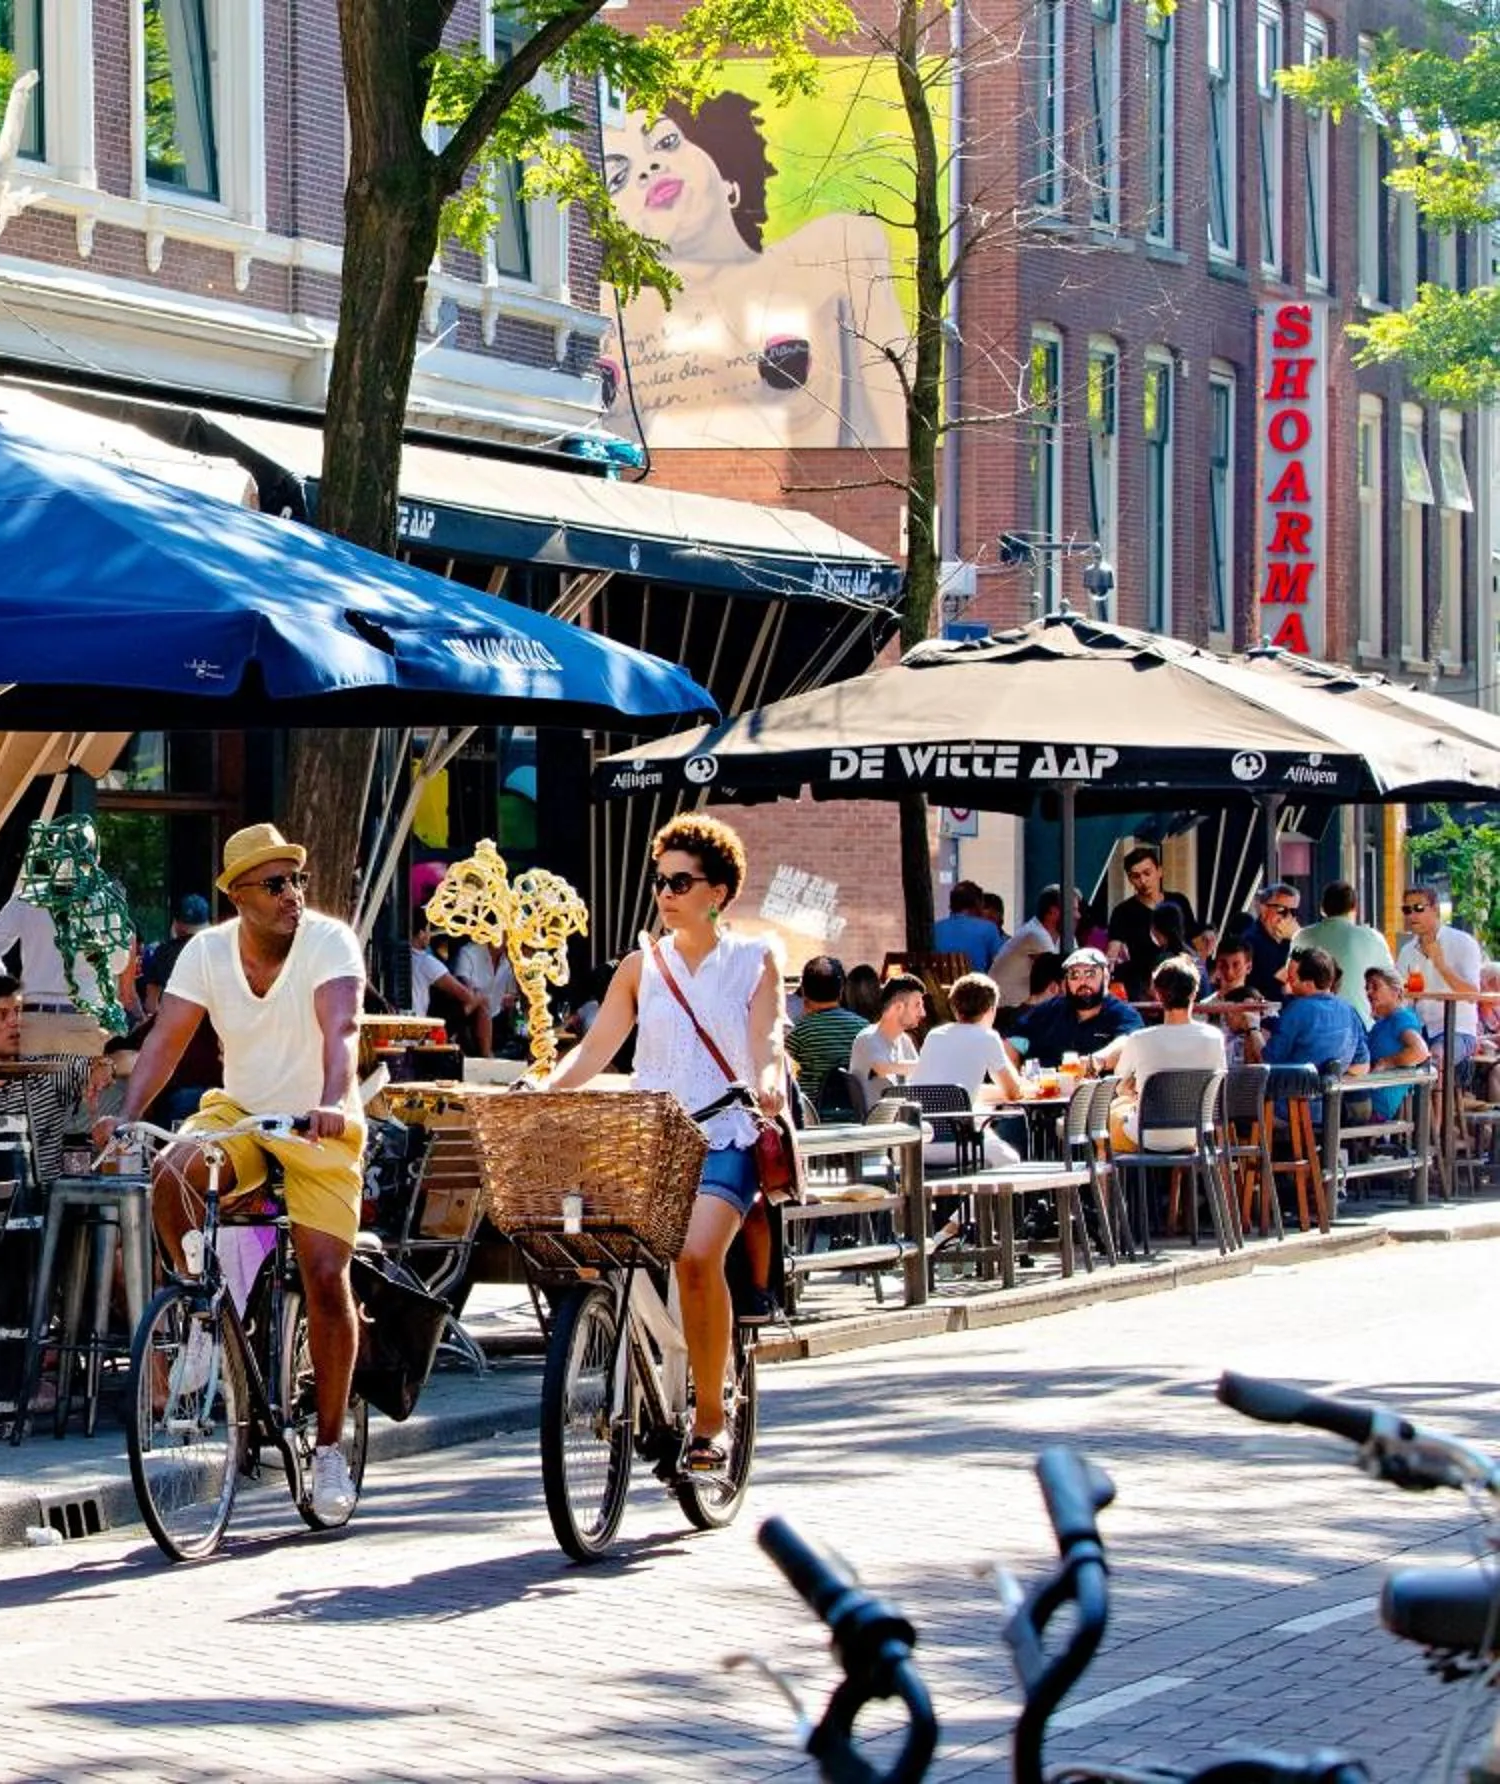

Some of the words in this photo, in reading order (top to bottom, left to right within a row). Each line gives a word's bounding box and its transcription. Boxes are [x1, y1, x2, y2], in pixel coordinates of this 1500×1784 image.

[1260, 305, 1317, 654] SHOARMA
[409, 508, 435, 540] AAP
[829, 747, 885, 781] DE
[897, 745, 1021, 779] WITTE
[1028, 745, 1119, 779] AAP
[1282, 766, 1338, 786] Affligem
[610, 772, 663, 789] Affligem
